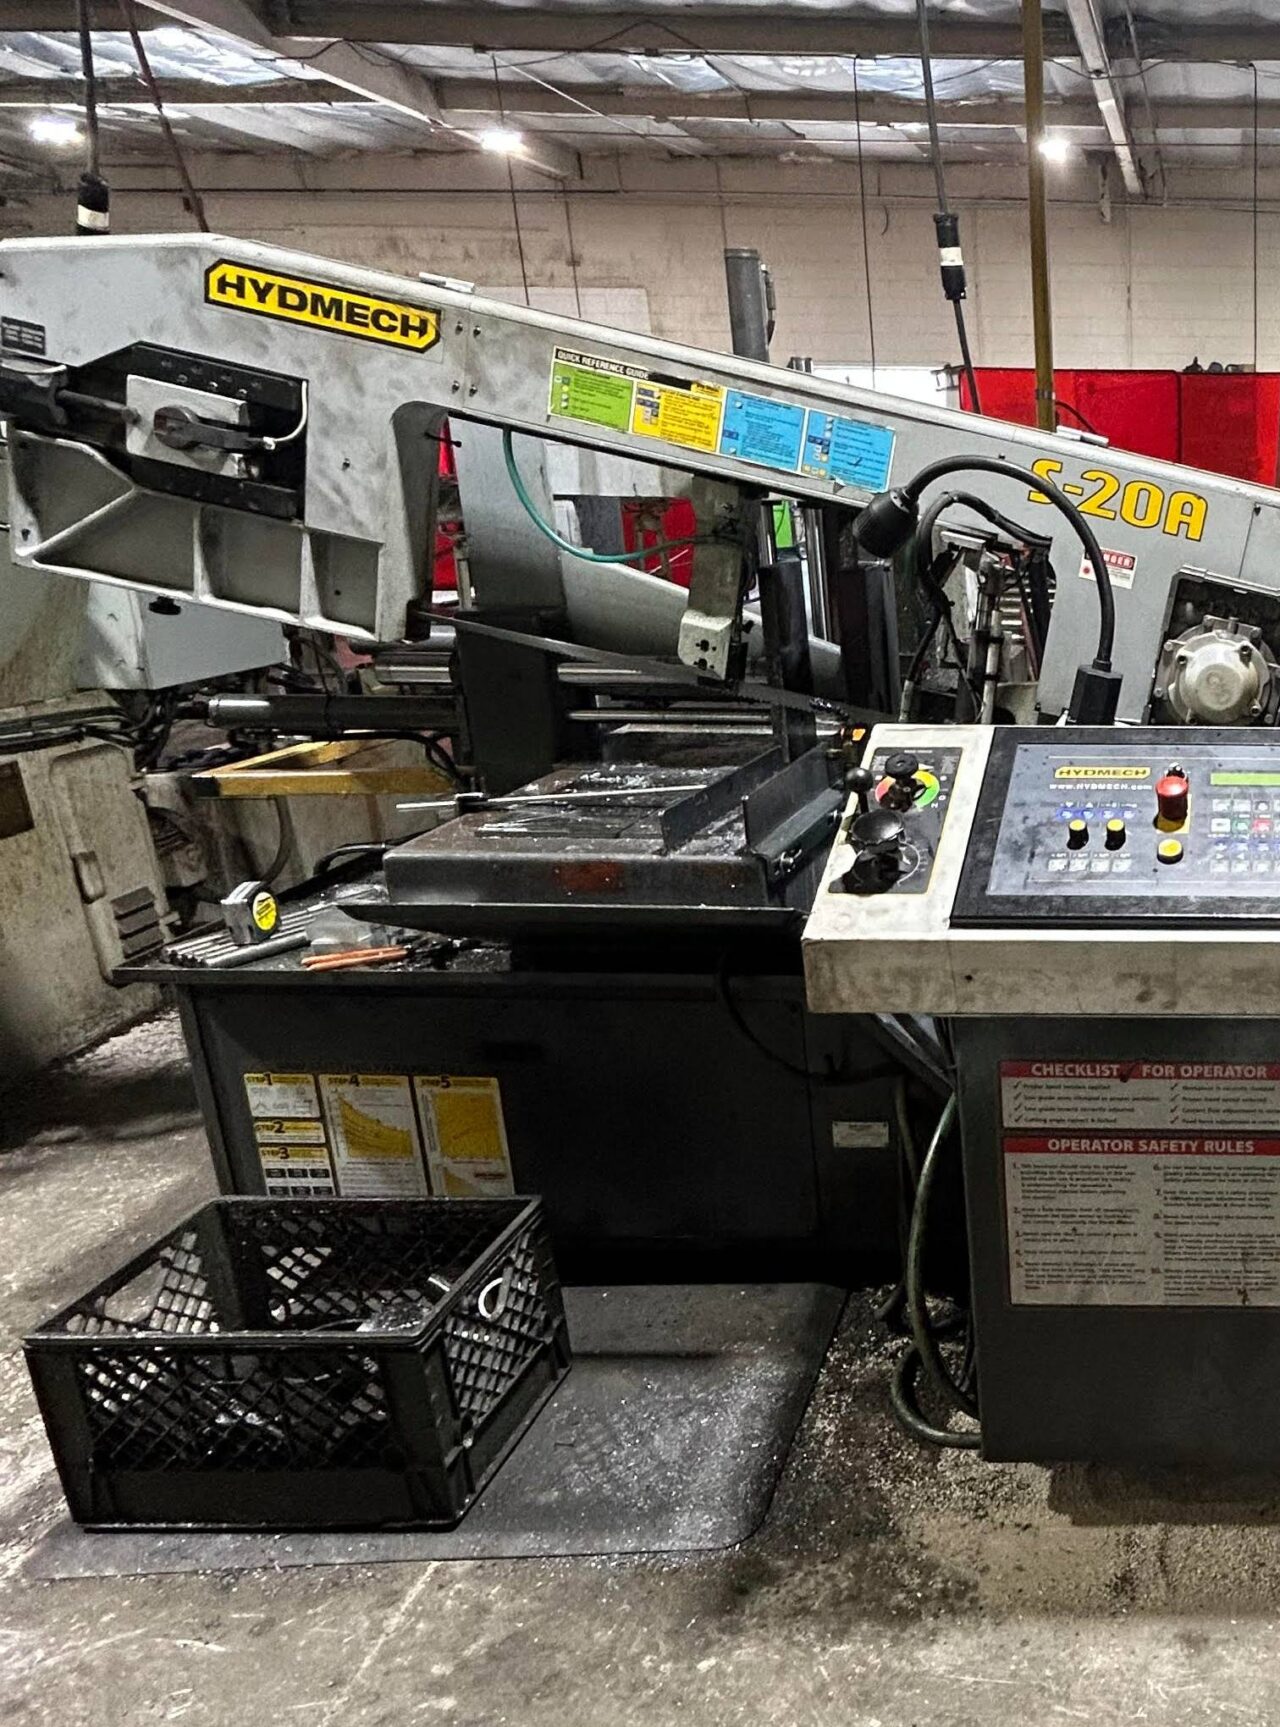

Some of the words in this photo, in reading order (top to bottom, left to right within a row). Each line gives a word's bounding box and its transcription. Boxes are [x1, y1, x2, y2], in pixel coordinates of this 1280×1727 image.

[217, 273, 428, 339] HYDMECH
[557, 351, 581, 364] QUICK
[582, 356, 625, 375] REFERENCE
[626, 367, 649, 380] GUIDE
[1028, 458, 1208, 542] S-20A
[1059, 768, 1148, 777] HYDMECH
[1031, 1063, 1120, 1077] CHECKLIST
[1141, 1065, 1175, 1077] FOR
[1180, 1065, 1268, 1078] OPERATOR
[264, 1072, 273, 1086] 1
[349, 1074, 360, 1087] 4
[441, 1074, 452, 1088] 5
[273, 1121, 286, 1134] 2
[1047, 1138, 1134, 1152] OPERATOR
[1138, 1140, 1198, 1152] SAFETY
[1204, 1140, 1255, 1153] RULES
[279, 1147, 291, 1160] 3
